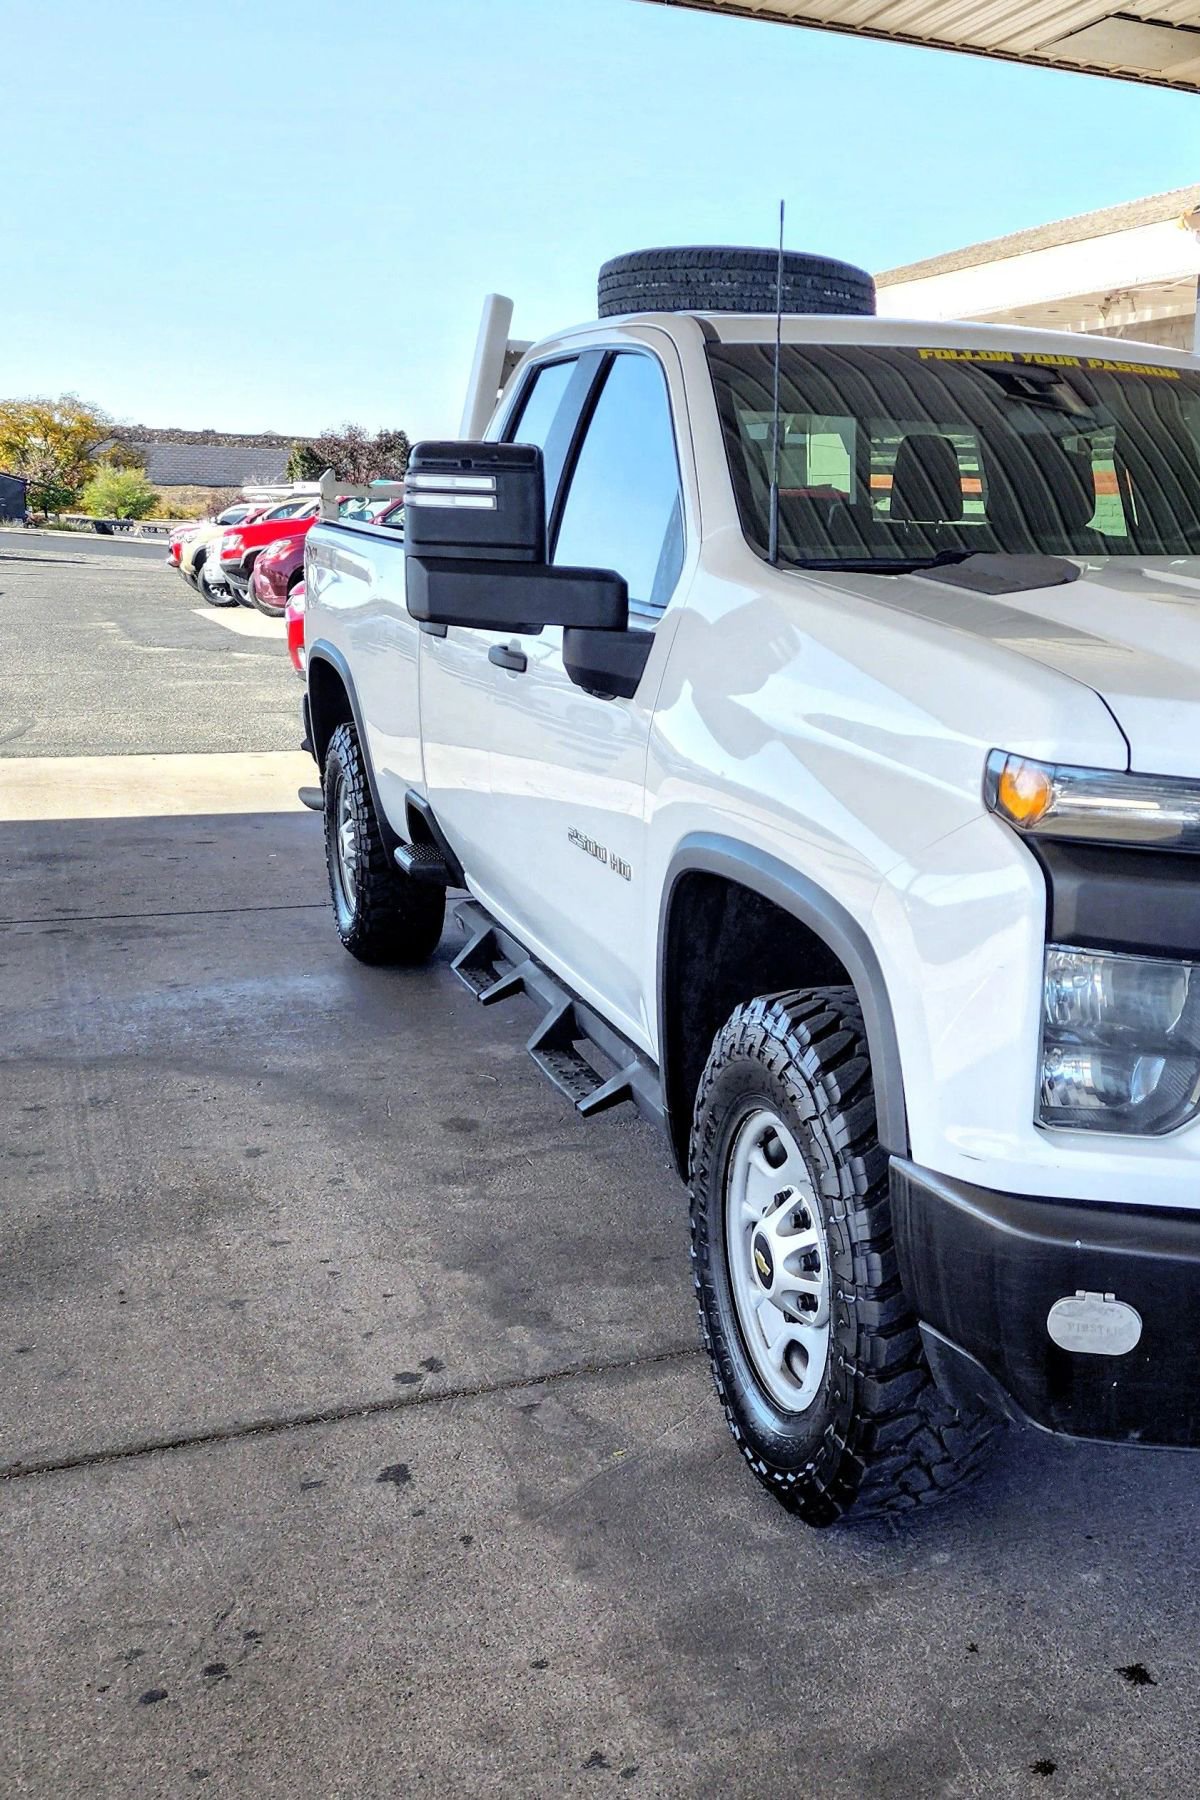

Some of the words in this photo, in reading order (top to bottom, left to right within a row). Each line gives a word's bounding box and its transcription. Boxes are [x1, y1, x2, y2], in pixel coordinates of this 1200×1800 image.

[918, 348, 1015, 362] FOLLOW
[1021, 353, 1082, 368] YOUR
[1086, 358, 1180, 379] PASSION
[568, 825, 607, 864] 2500
[609, 851, 631, 881] HD
